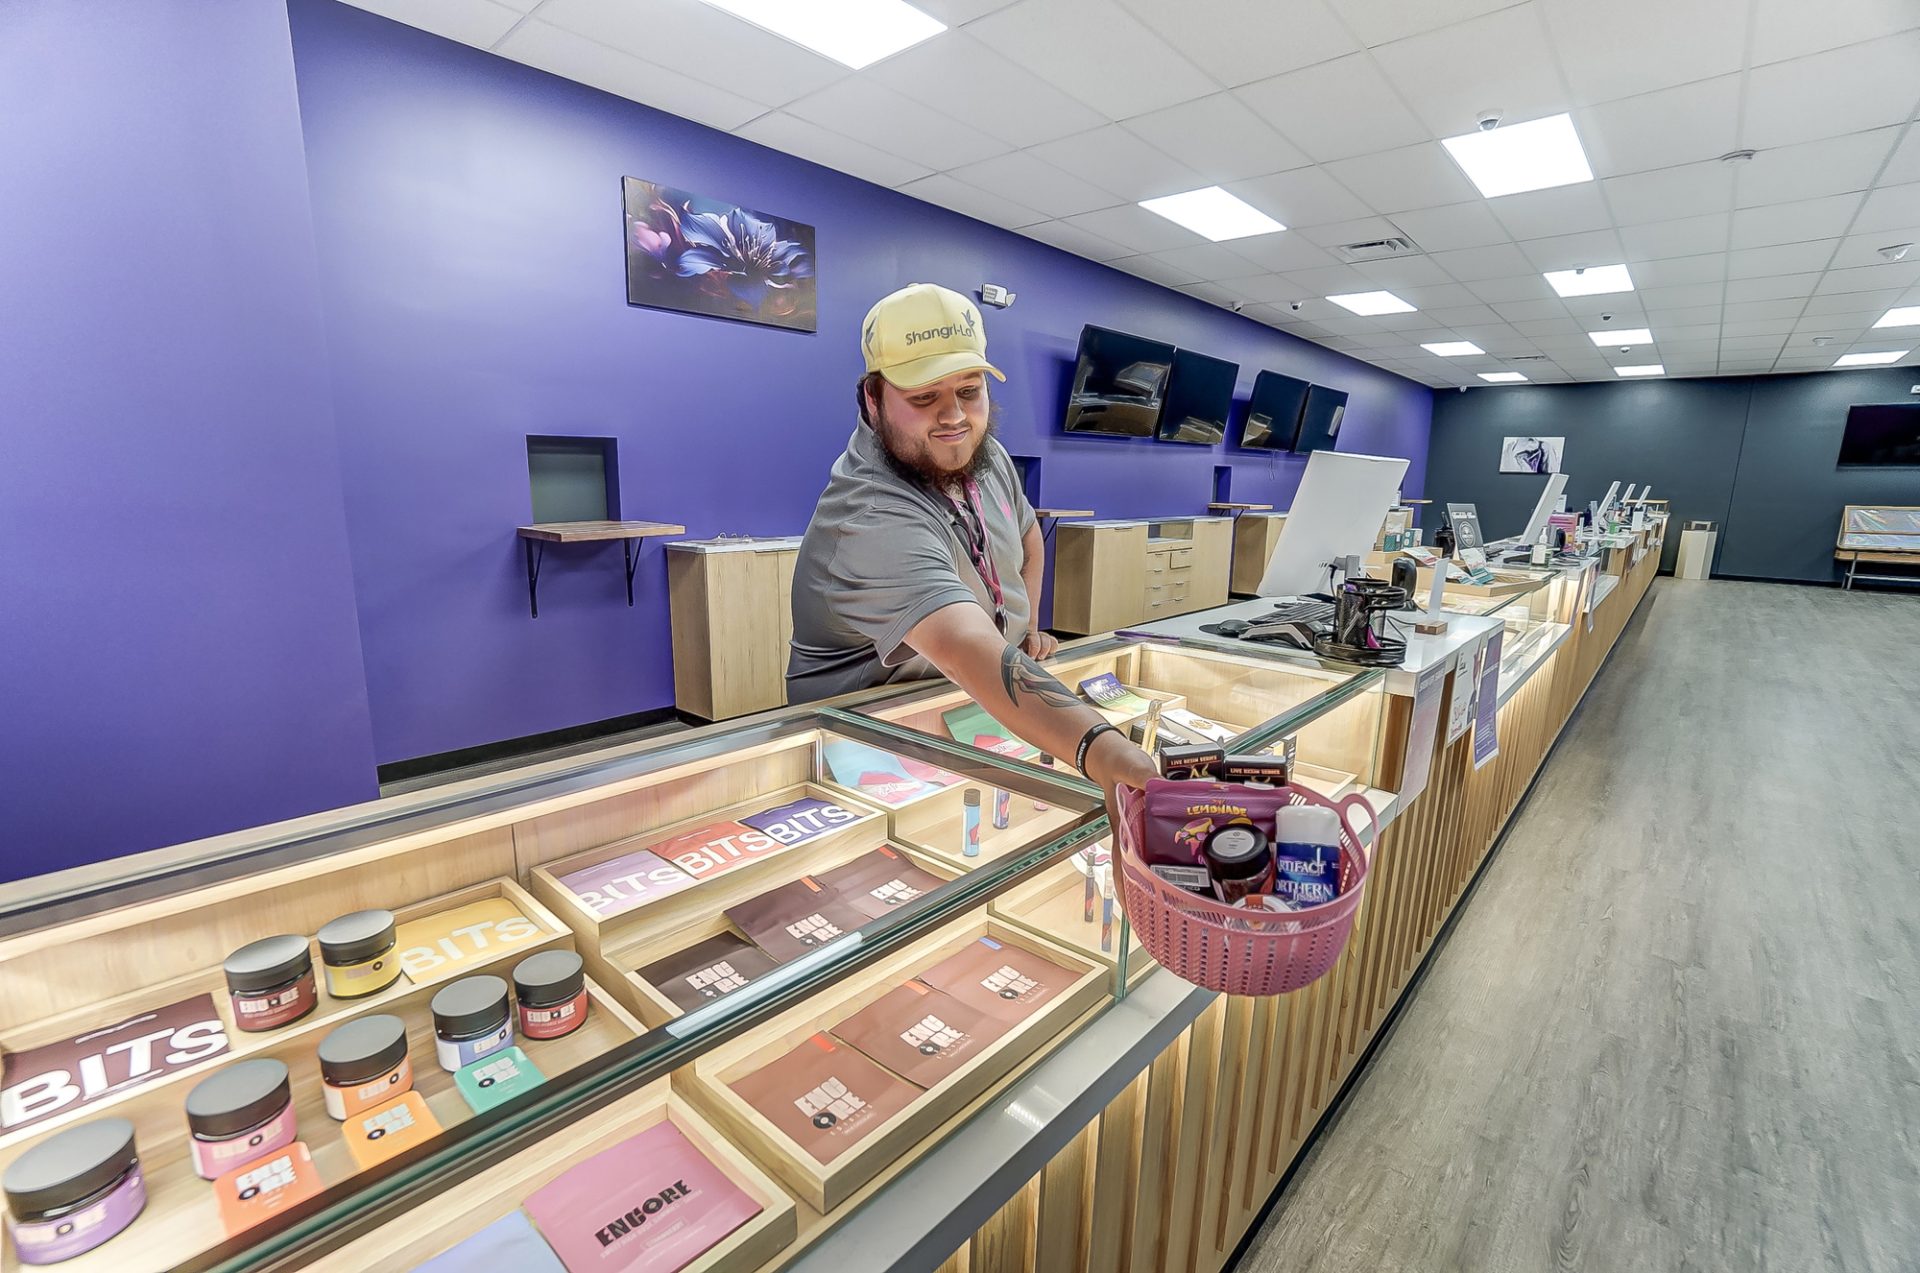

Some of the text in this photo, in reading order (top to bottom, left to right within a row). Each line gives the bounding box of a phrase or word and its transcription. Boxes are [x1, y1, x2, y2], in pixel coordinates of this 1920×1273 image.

[905, 324, 973, 346] Shangri-La
[764, 804, 856, 843] BITS
[1186, 804, 1248, 817] LEMONADE
[671, 831, 777, 875] BITS
[577, 865, 683, 911] BITS
[399, 916, 539, 976] BITS
[0, 1019, 229, 1128] BITS
[594, 1179, 692, 1248] ENCORE
